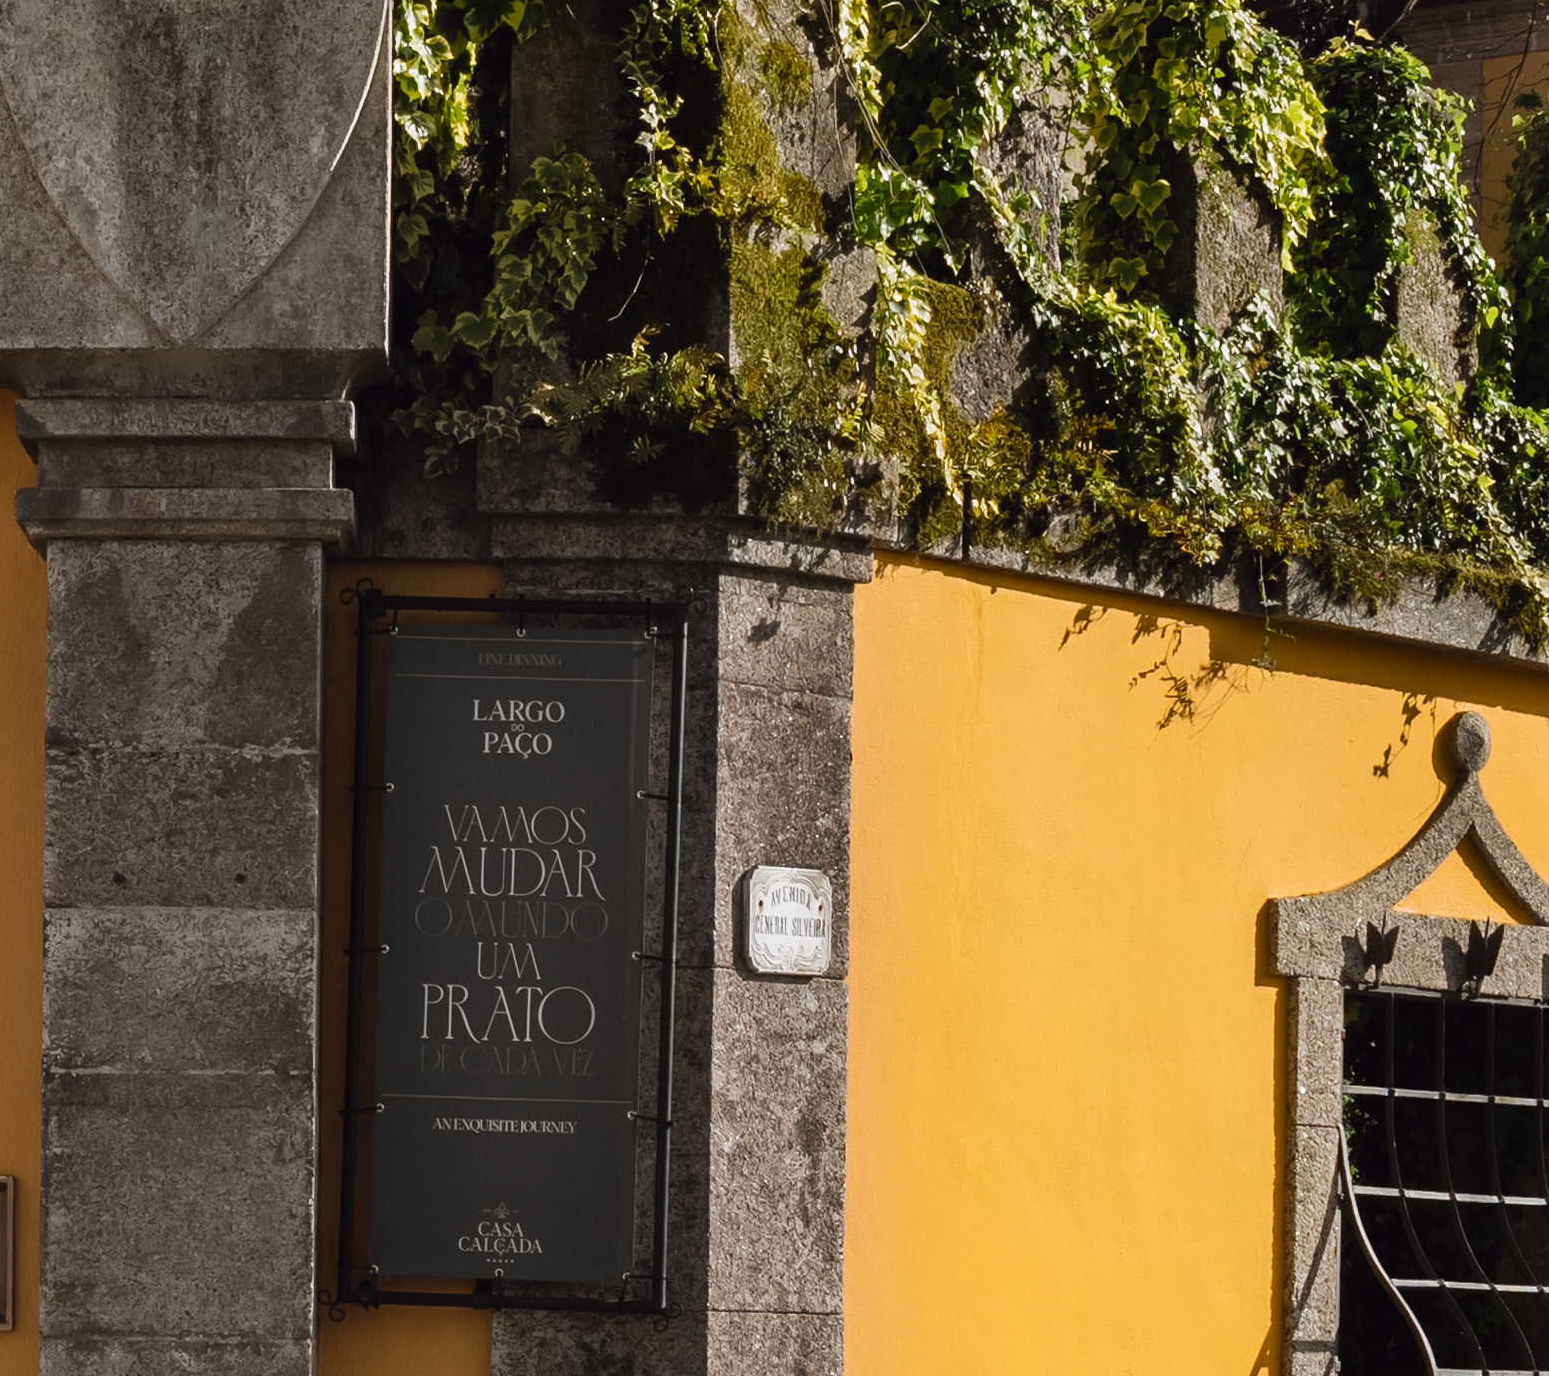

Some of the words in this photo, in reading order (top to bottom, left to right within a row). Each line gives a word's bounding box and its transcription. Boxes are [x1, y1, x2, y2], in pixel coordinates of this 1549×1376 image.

[478, 652, 508, 665] FINE
[472, 699, 566, 723] LARGO
[511, 723, 525, 732] DO
[482, 731, 553, 760] PAÇO
[444, 804, 587, 845] VAMOS
[418, 845, 607, 902] MUDAR
[771, 886, 811, 911] AVENIDA
[414, 897, 453, 936] O
[454, 899, 609, 941] MUNDO
[754, 914, 788, 936] GENERAL
[791, 916, 827, 939] SILVEIRA
[477, 941, 542, 980] UM
[420, 983, 596, 1045] PRATO
[420, 1044, 452, 1072] DE
[460, 1045, 542, 1076] CADA
[552, 1047, 594, 1077] VEZ
[432, 1117, 452, 1131] AN
[453, 1118, 519, 1134] EXQUISITE
[519, 1120, 578, 1134] JOURNEY
[477, 1221, 524, 1238] CASA
[457, 1236, 544, 1256] CALÇADA
